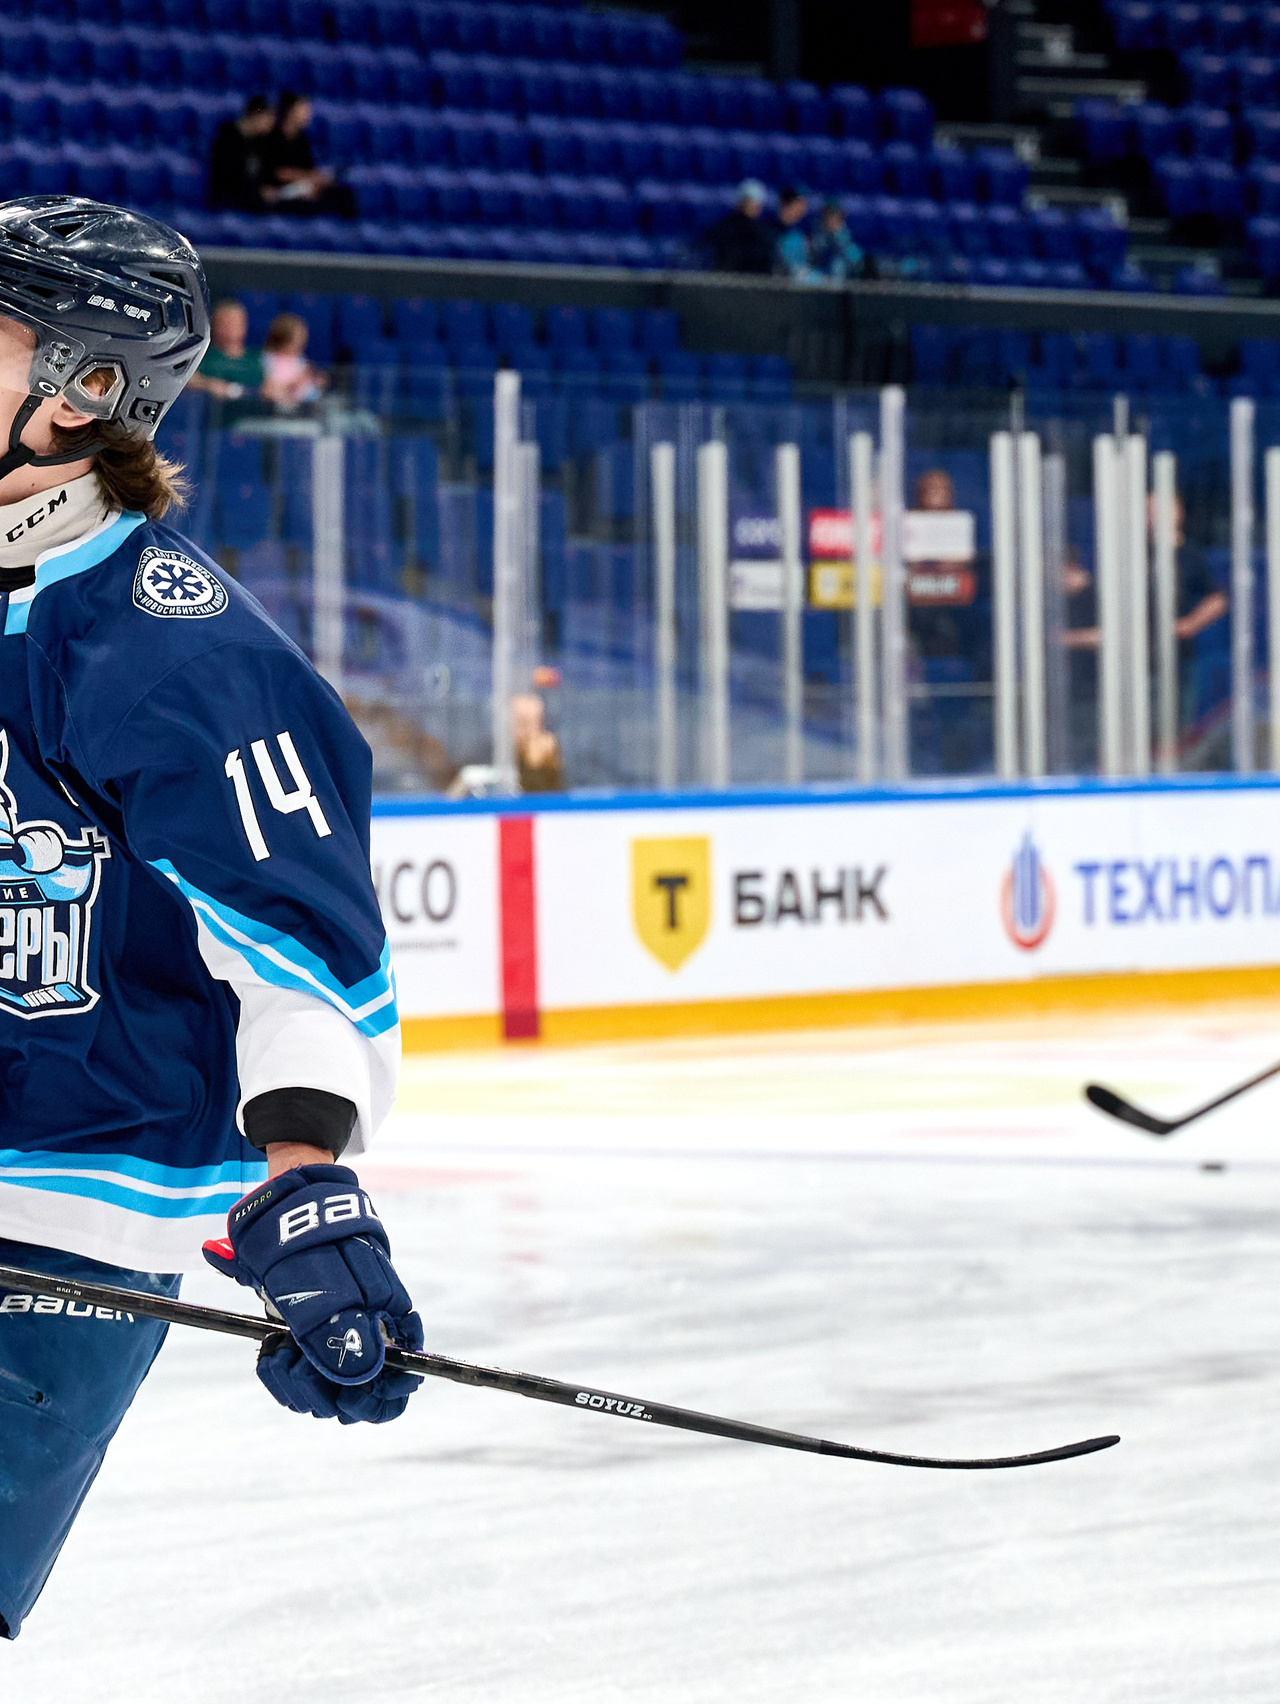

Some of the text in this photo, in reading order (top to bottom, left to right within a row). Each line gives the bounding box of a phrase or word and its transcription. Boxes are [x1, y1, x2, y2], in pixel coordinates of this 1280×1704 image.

[5, 490, 67, 542] CCM
[140, 595, 215, 615] НОВОСИБИРСКАЯ
[224, 730, 332, 862] 14
[733, 862, 890, 926] БАНК
[1074, 855, 1280, 926] ТЕХНОП
[575, 1392, 645, 1417] SOYUZ
